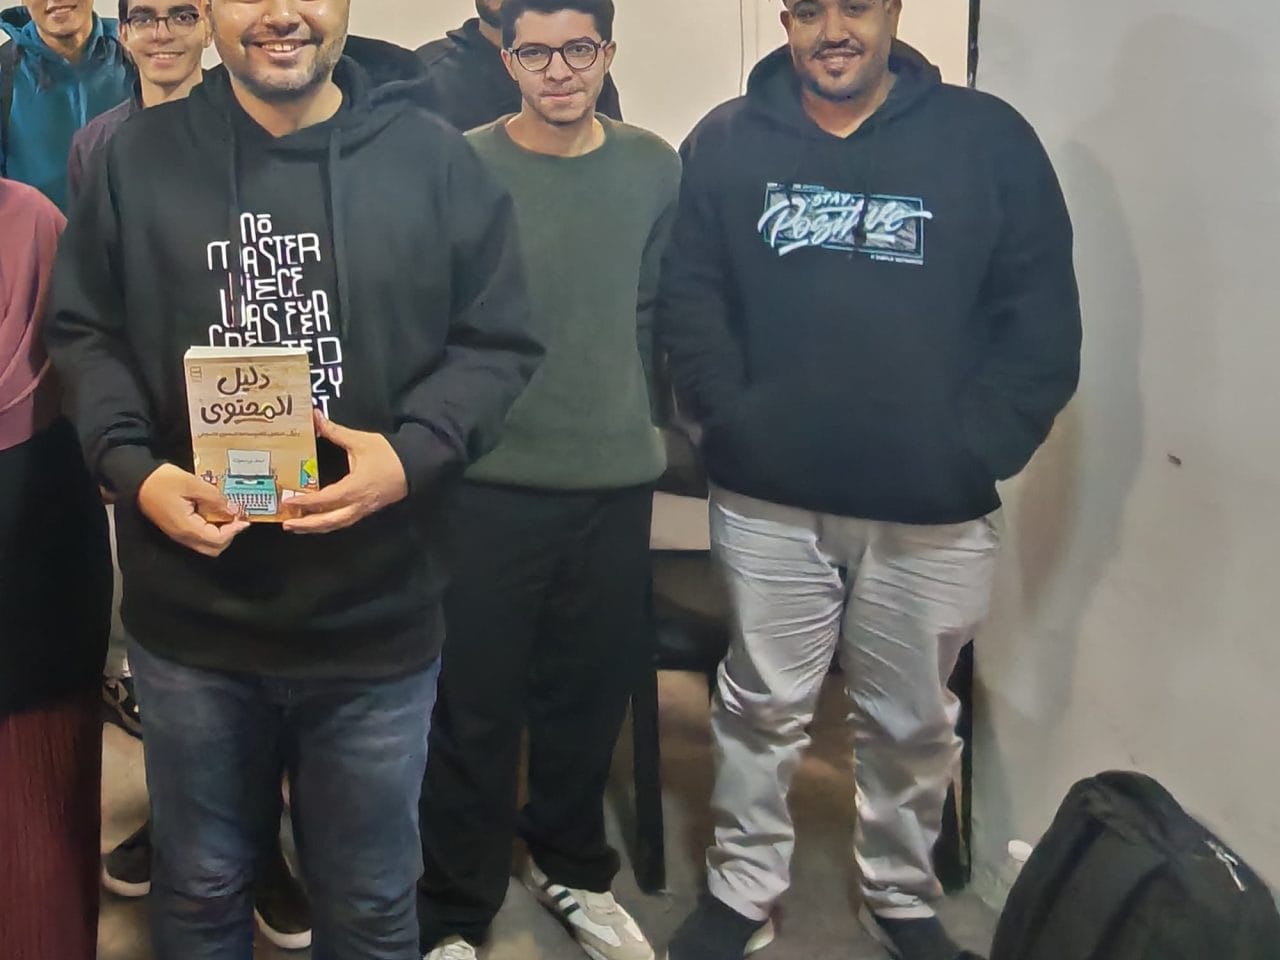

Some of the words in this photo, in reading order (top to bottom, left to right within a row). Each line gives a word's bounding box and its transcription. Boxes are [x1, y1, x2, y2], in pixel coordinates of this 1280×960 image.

[757, 196, 933, 248] Positve
[217, 366, 270, 395] دليل
[201, 394, 293, 424] المحتوى
